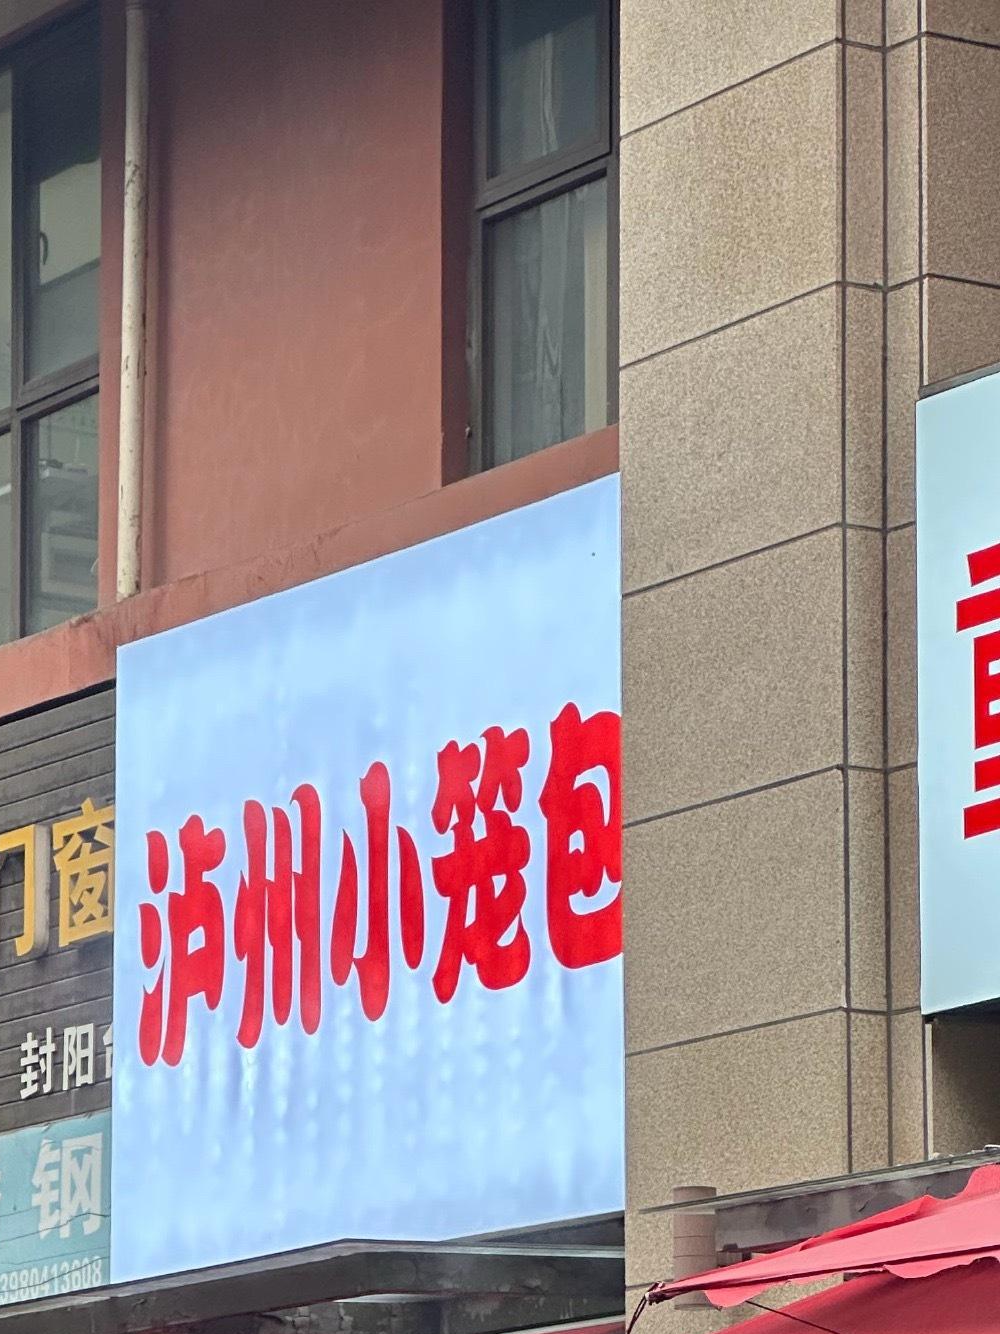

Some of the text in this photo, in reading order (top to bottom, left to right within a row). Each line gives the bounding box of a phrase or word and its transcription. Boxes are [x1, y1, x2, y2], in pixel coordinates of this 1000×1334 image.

[139, 702, 622, 1067] 泸州小笼包
